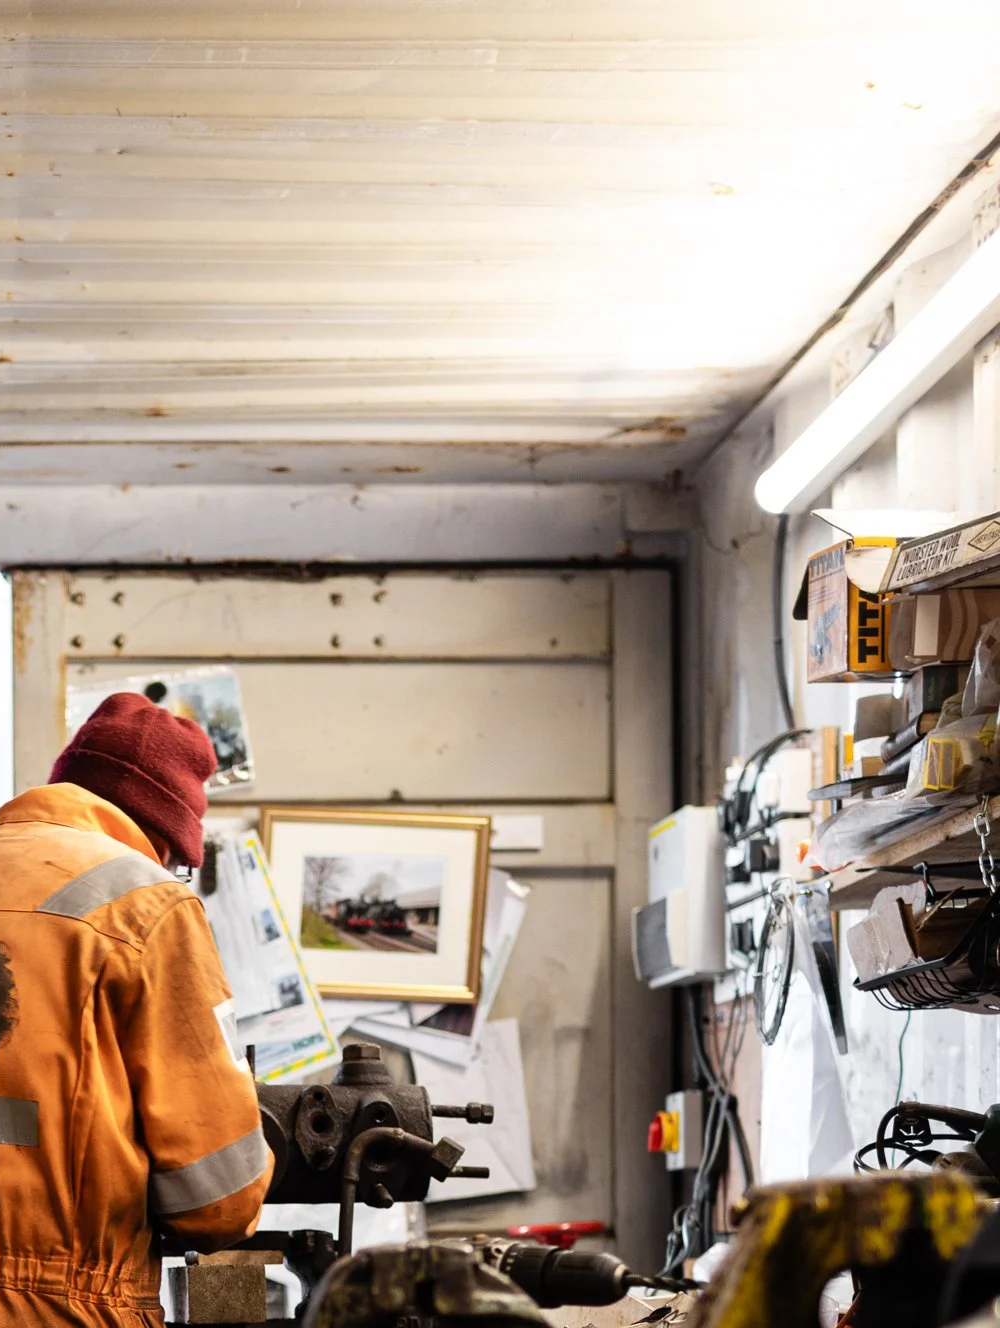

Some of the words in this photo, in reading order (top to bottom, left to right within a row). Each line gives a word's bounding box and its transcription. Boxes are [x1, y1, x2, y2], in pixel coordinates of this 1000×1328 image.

[809, 547, 845, 578] TITAN
[896, 553, 943, 581] LUBRICATOR
[942, 548, 958, 568] KIT
[903, 540, 940, 565] WORSTED
[940, 532, 961, 553] WOOL
[857, 586, 880, 664] TIT
